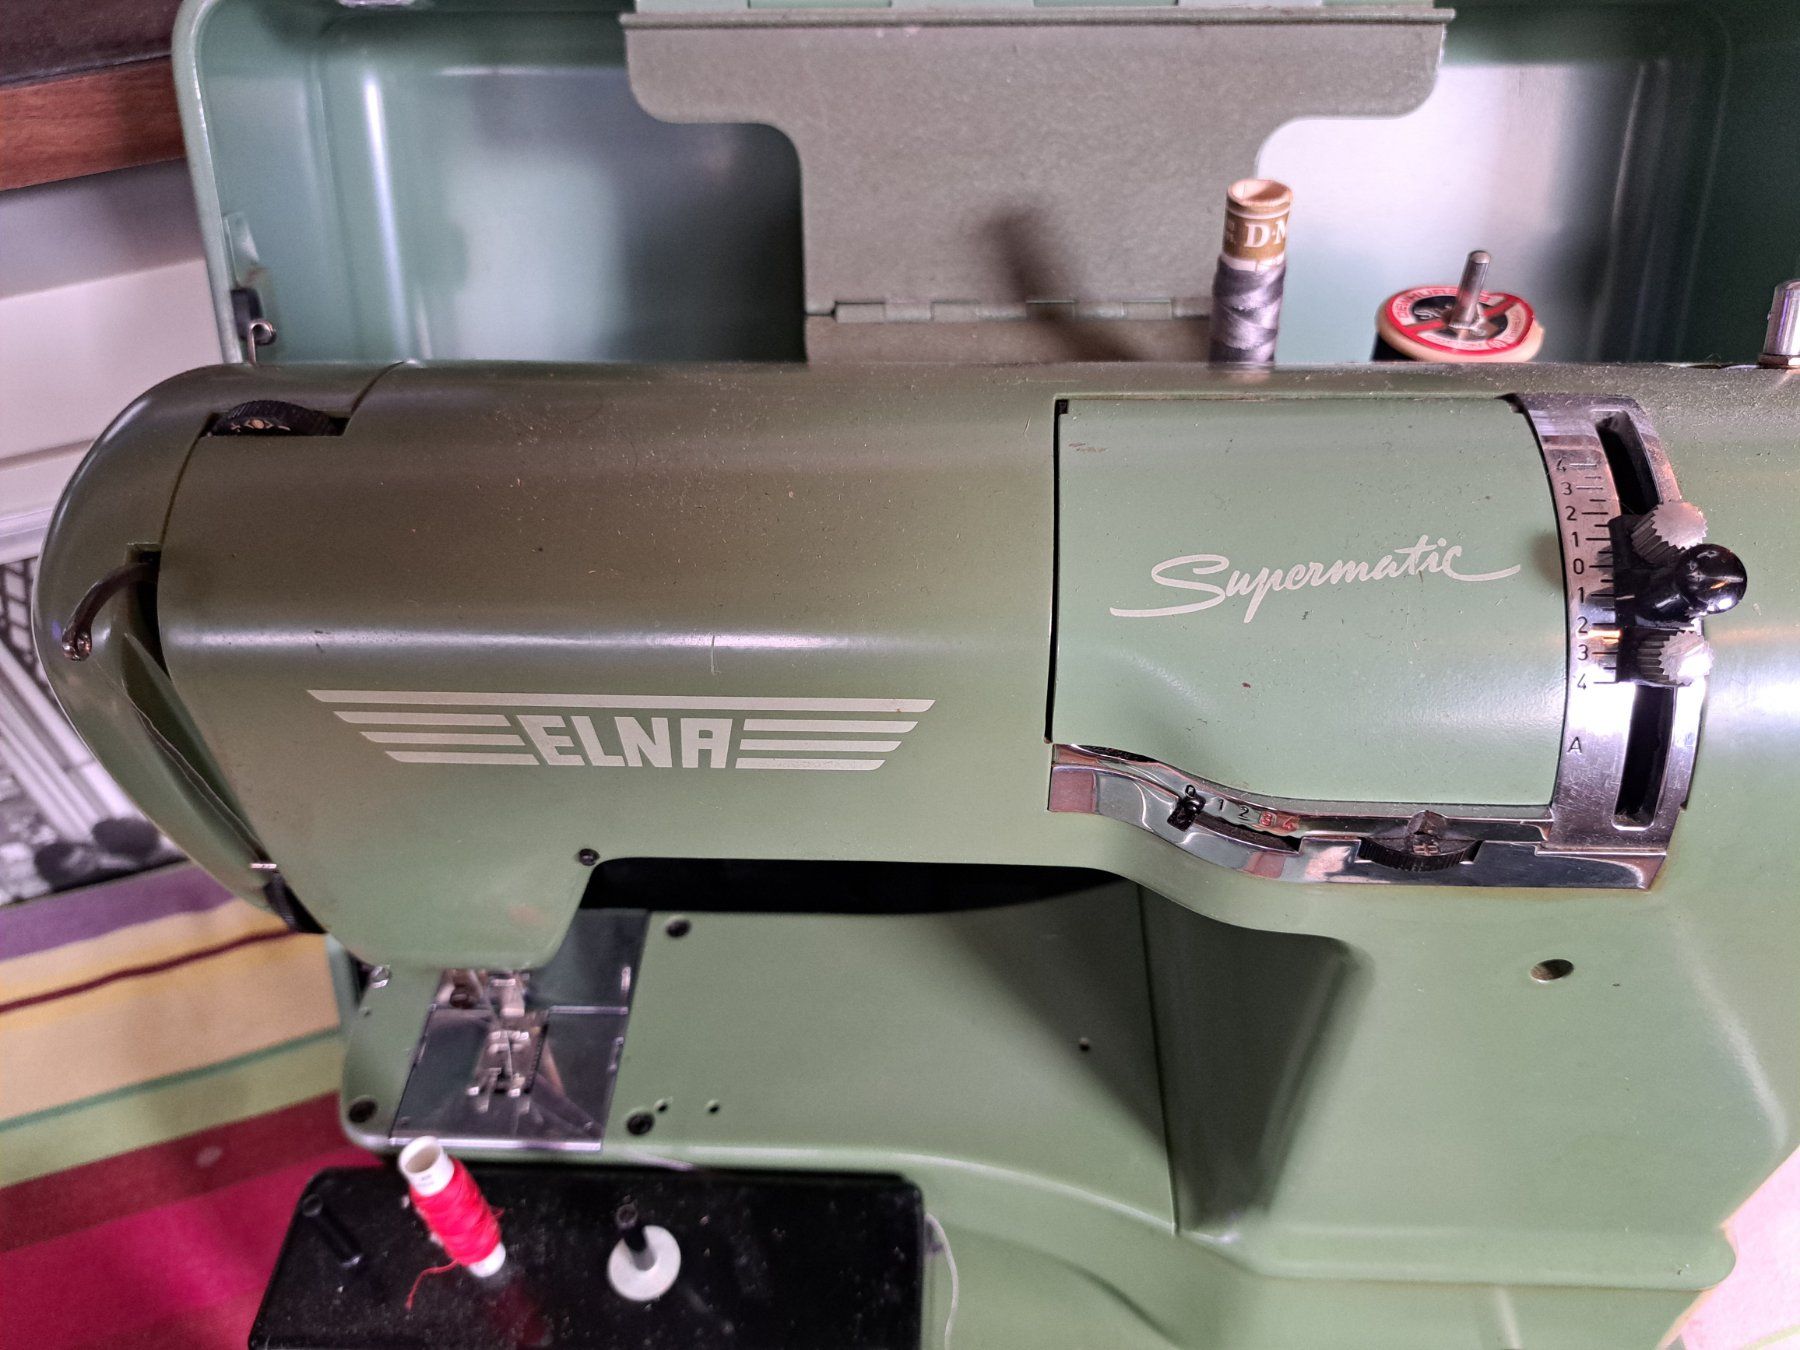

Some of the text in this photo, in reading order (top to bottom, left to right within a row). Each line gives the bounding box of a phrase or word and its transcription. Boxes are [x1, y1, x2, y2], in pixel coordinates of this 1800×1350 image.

[1562, 482, 1573, 496] 3
[1566, 506, 1577, 521] 2
[1571, 531, 1579, 547] 1
[1573, 558, 1584, 574] 0
[1109, 534, 1521, 623] Supermatic
[1577, 586, 1585, 603] 1
[1577, 616, 1588, 633] 2
[1577, 644, 1588, 660] 3
[1577, 673, 1587, 690] 4
[515, 713, 734, 769] ELNA
[1567, 736, 1583, 753] A
[1239, 806, 1250, 818] 2
